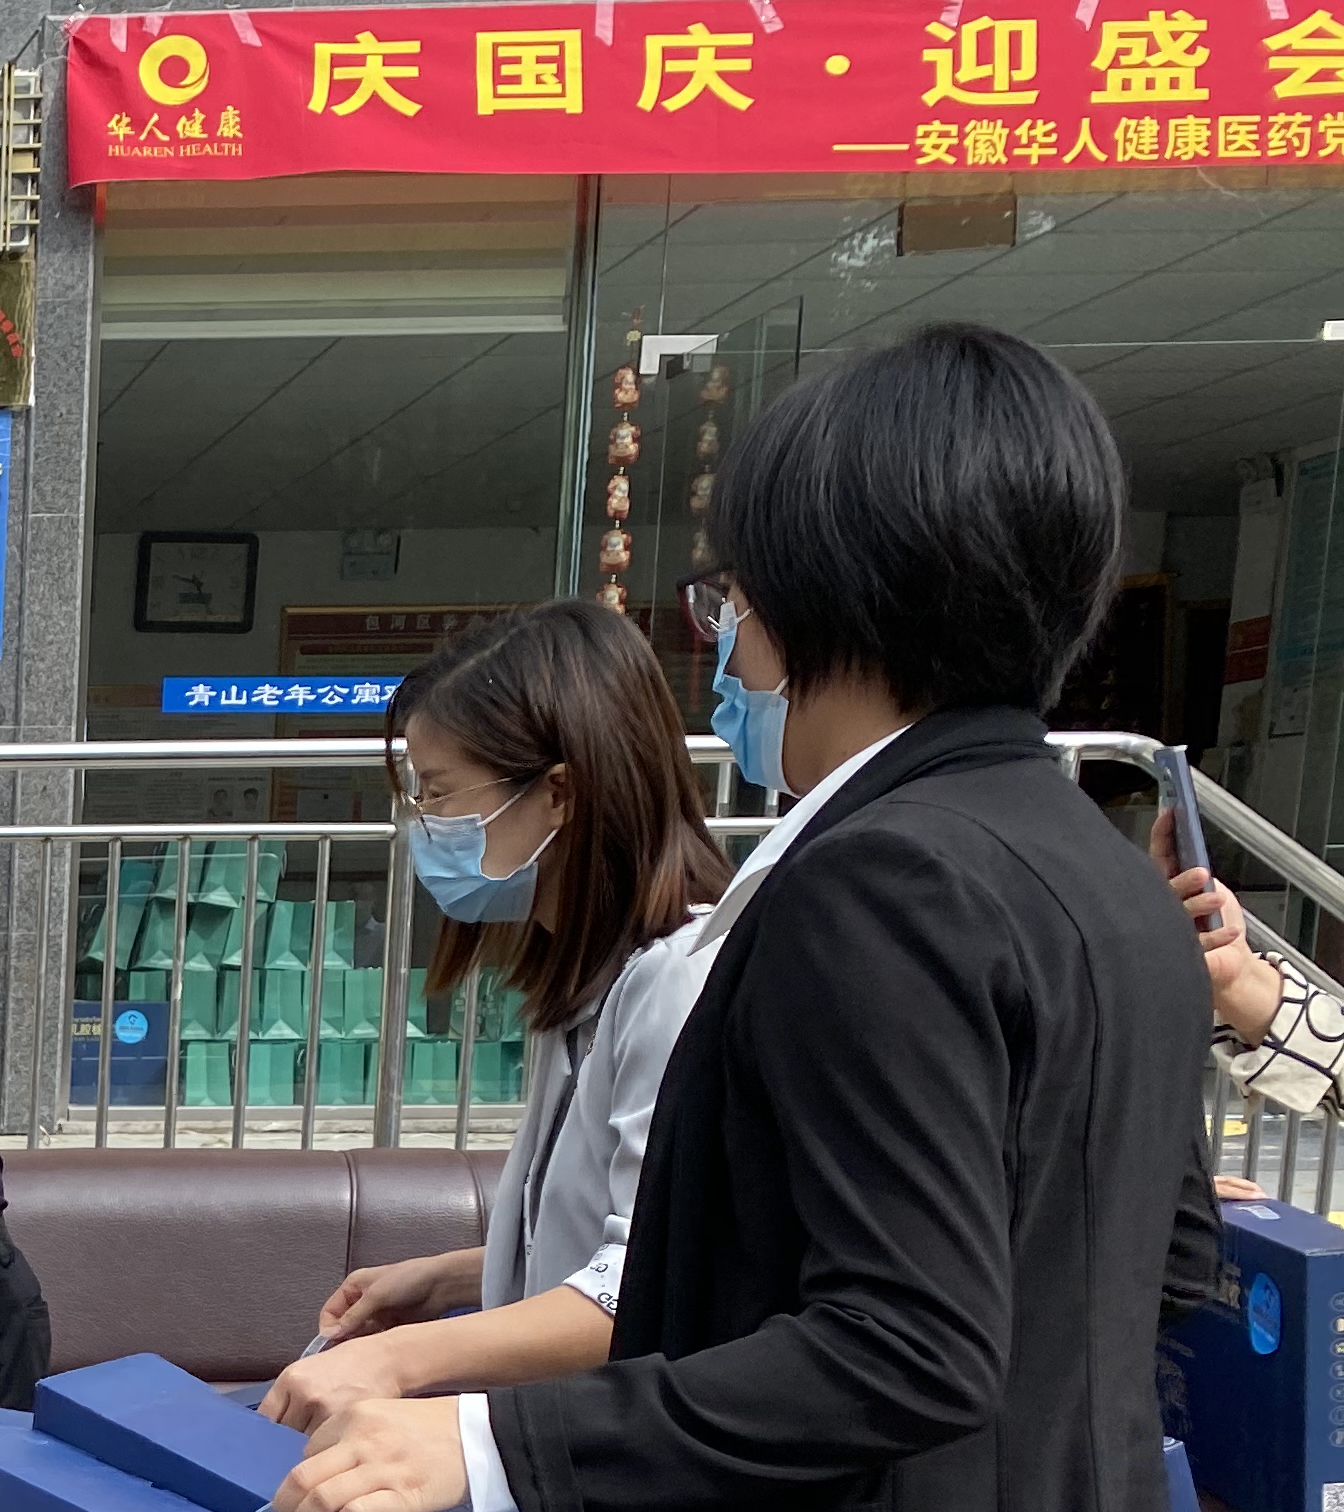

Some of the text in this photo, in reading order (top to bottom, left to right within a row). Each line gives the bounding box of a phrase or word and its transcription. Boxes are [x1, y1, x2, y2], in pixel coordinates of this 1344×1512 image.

[106, 105, 244, 143] 华人健康
[107, 142, 244, 158] HUAREN HEALTH
